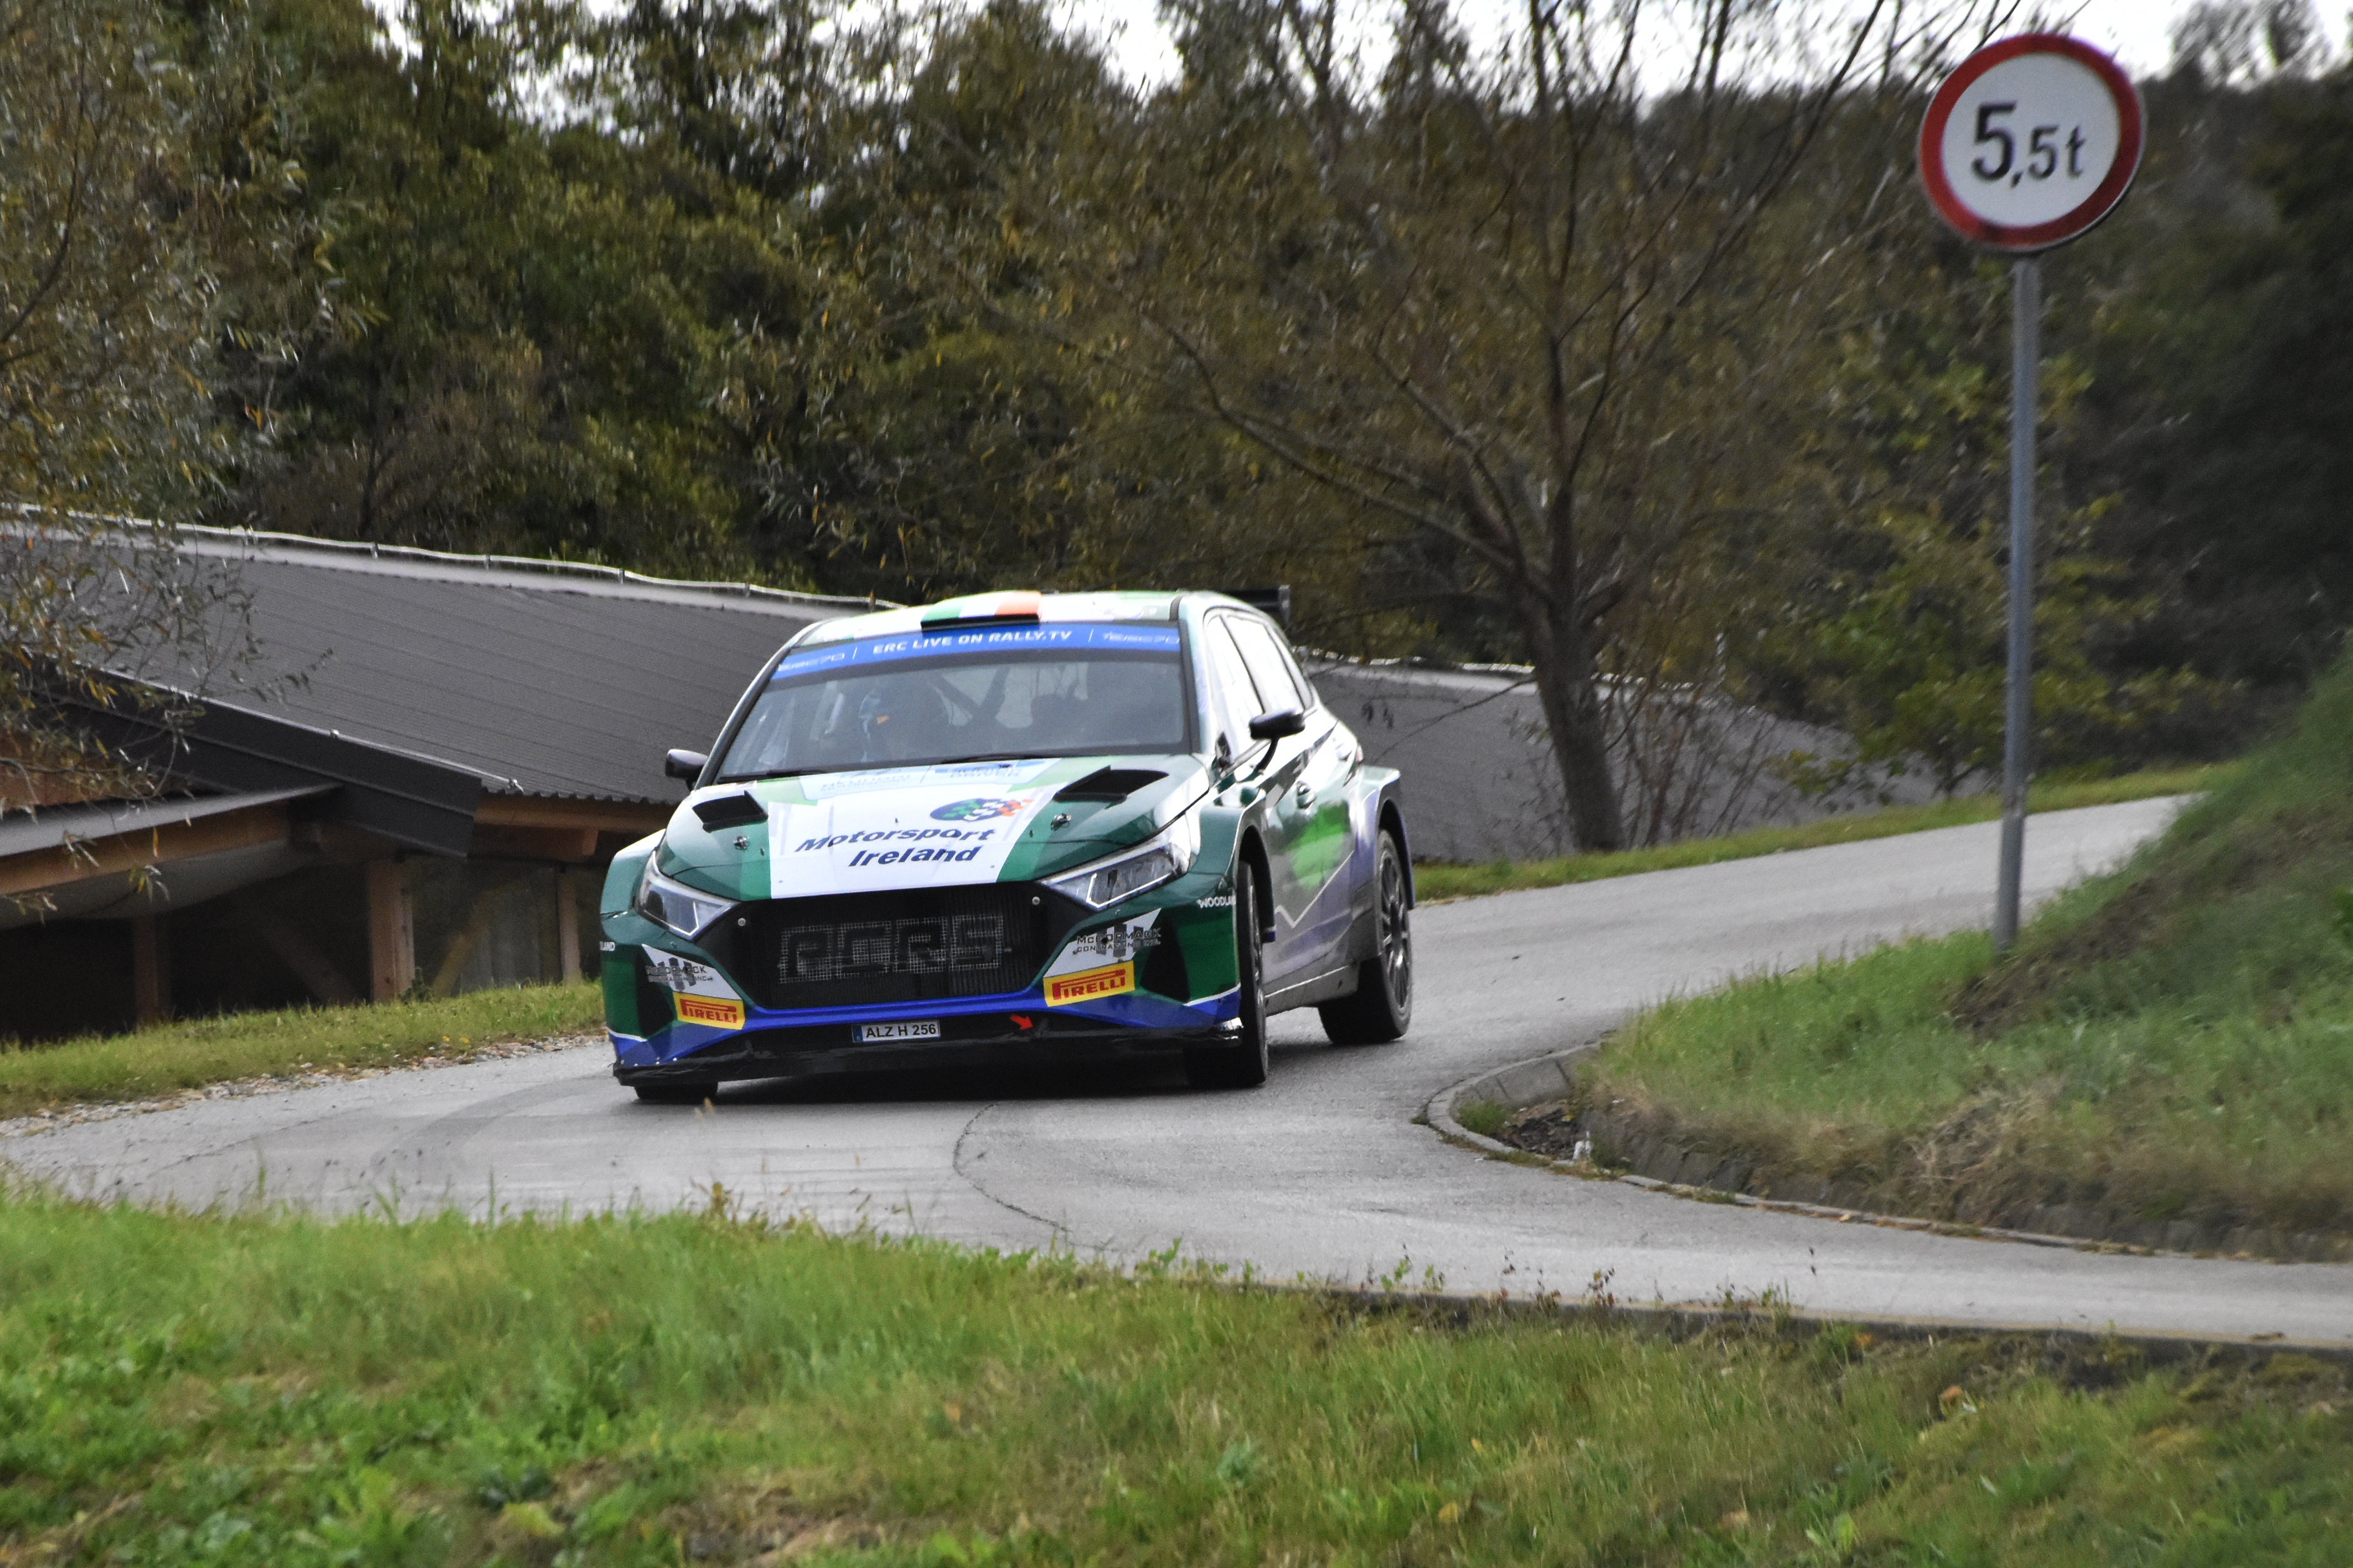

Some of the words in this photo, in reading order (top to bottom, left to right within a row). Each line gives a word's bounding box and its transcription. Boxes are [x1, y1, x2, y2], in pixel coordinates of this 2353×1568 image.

[1970, 99, 2086, 189] 5,5t
[873, 641, 908, 654] ERC
[912, 636, 953, 649] LIVE
[958, 634, 983, 645] ON
[988, 630, 1072, 643] RALLY.TV
[794, 828, 996, 852] Motorsport
[848, 846, 983, 867] Ireland
[1052, 969, 1126, 1000] PIRELLI
[680, 998, 737, 1023] PIRELLI
[866, 1026, 894, 1038] ALZ
[898, 1025, 908, 1037] H
[912, 1023, 937, 1036] 256
